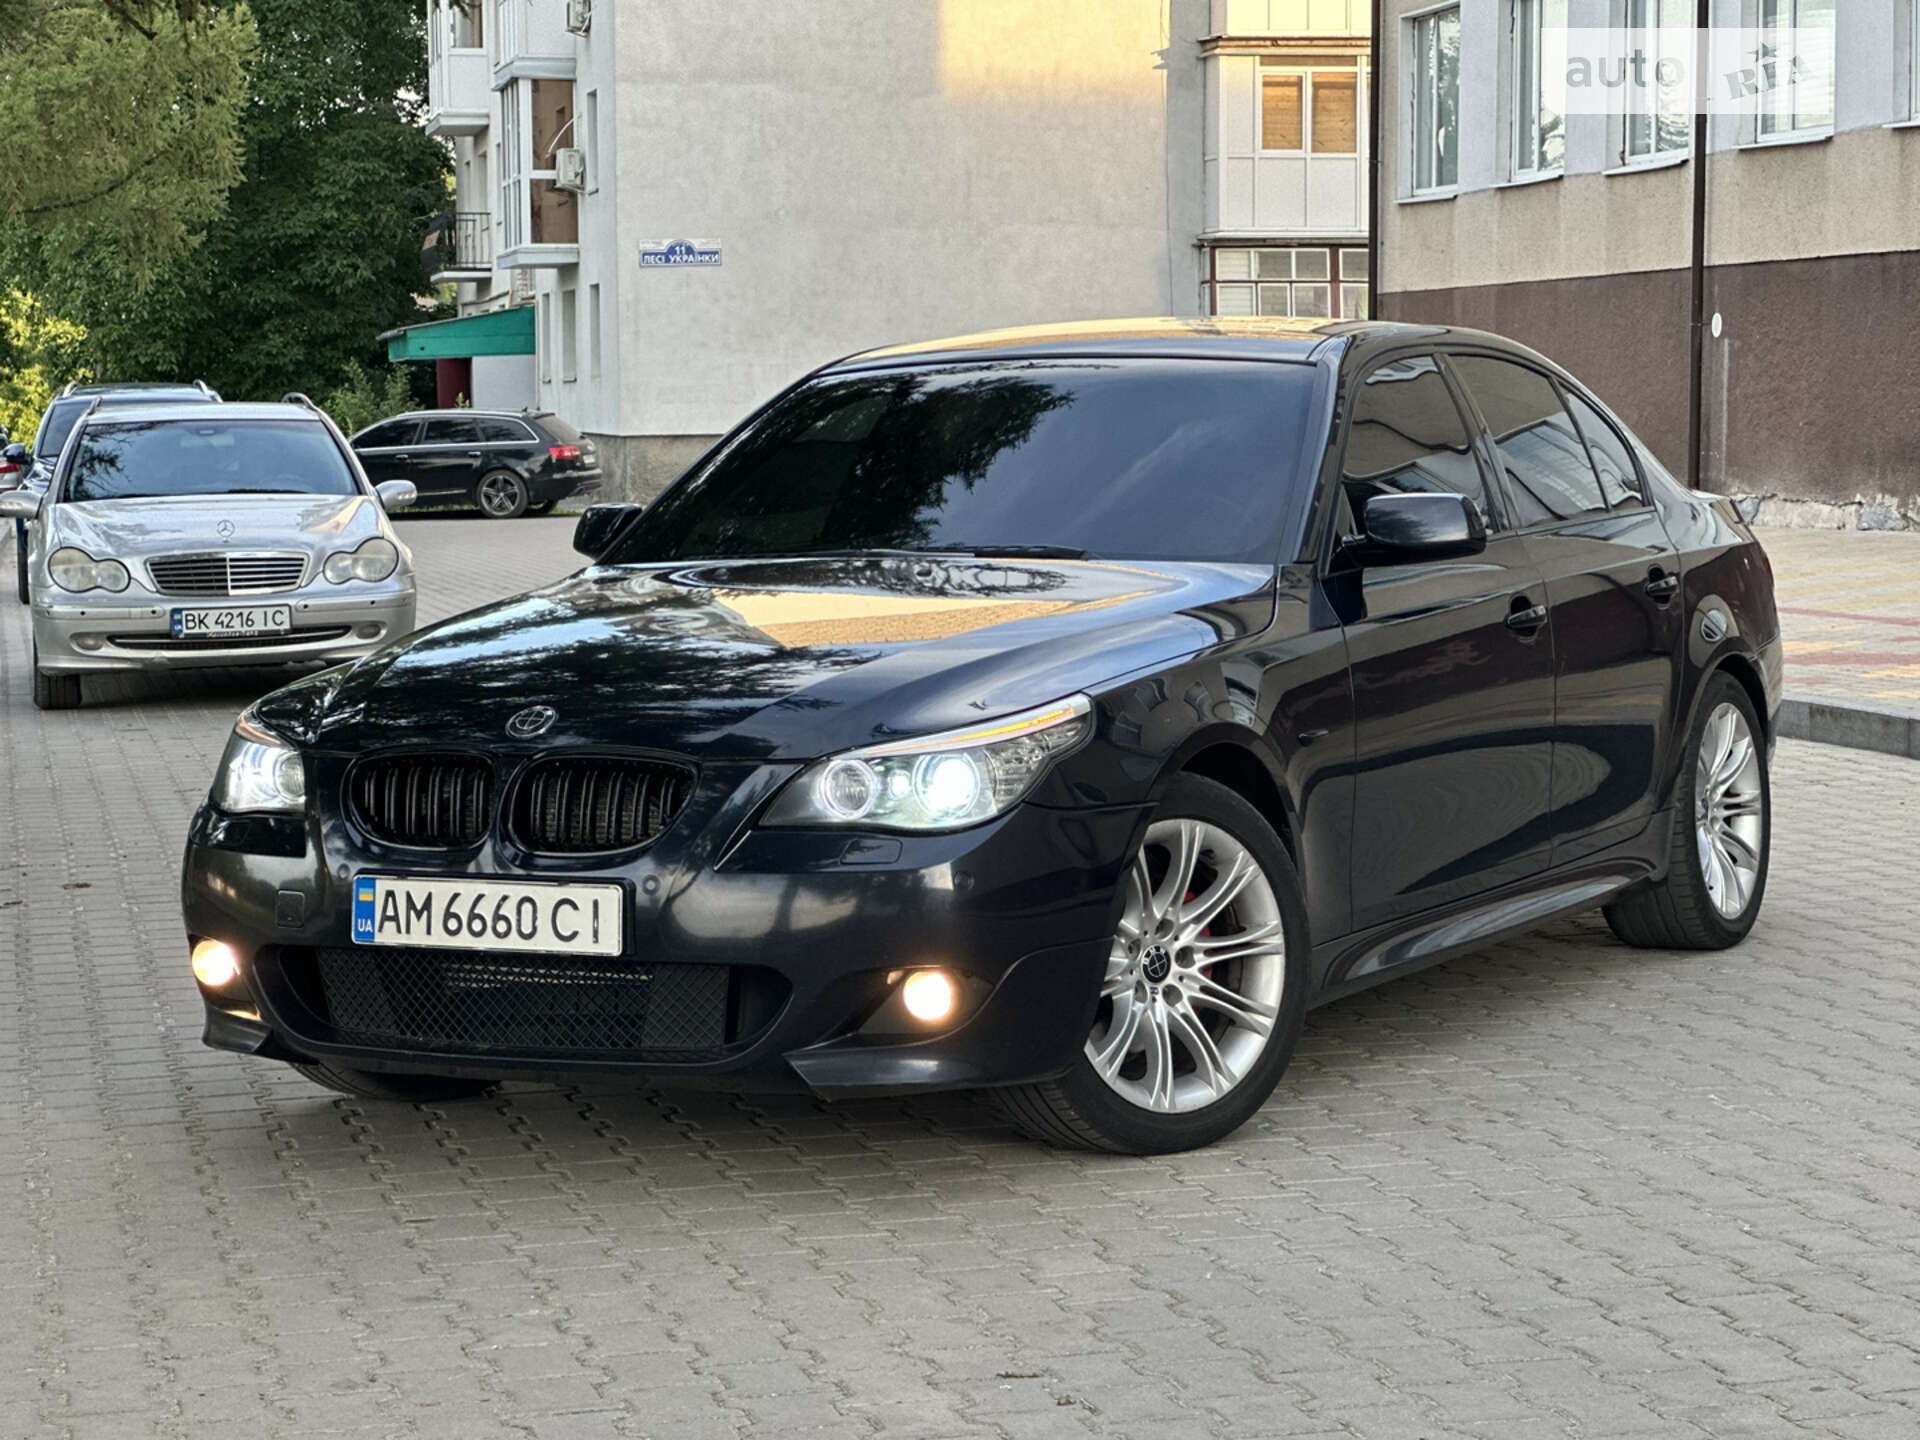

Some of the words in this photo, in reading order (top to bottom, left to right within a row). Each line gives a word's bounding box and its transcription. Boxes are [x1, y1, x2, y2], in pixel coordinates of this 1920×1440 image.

[675, 246, 686, 255] 11
[184, 612, 210, 631] BK
[214, 611, 256, 629] 4216
[263, 609, 285, 628] IC
[357, 918, 373, 934] UA
[377, 889, 433, 936] AM
[442, 891, 539, 941] 6660
[551, 897, 600, 945] CI
